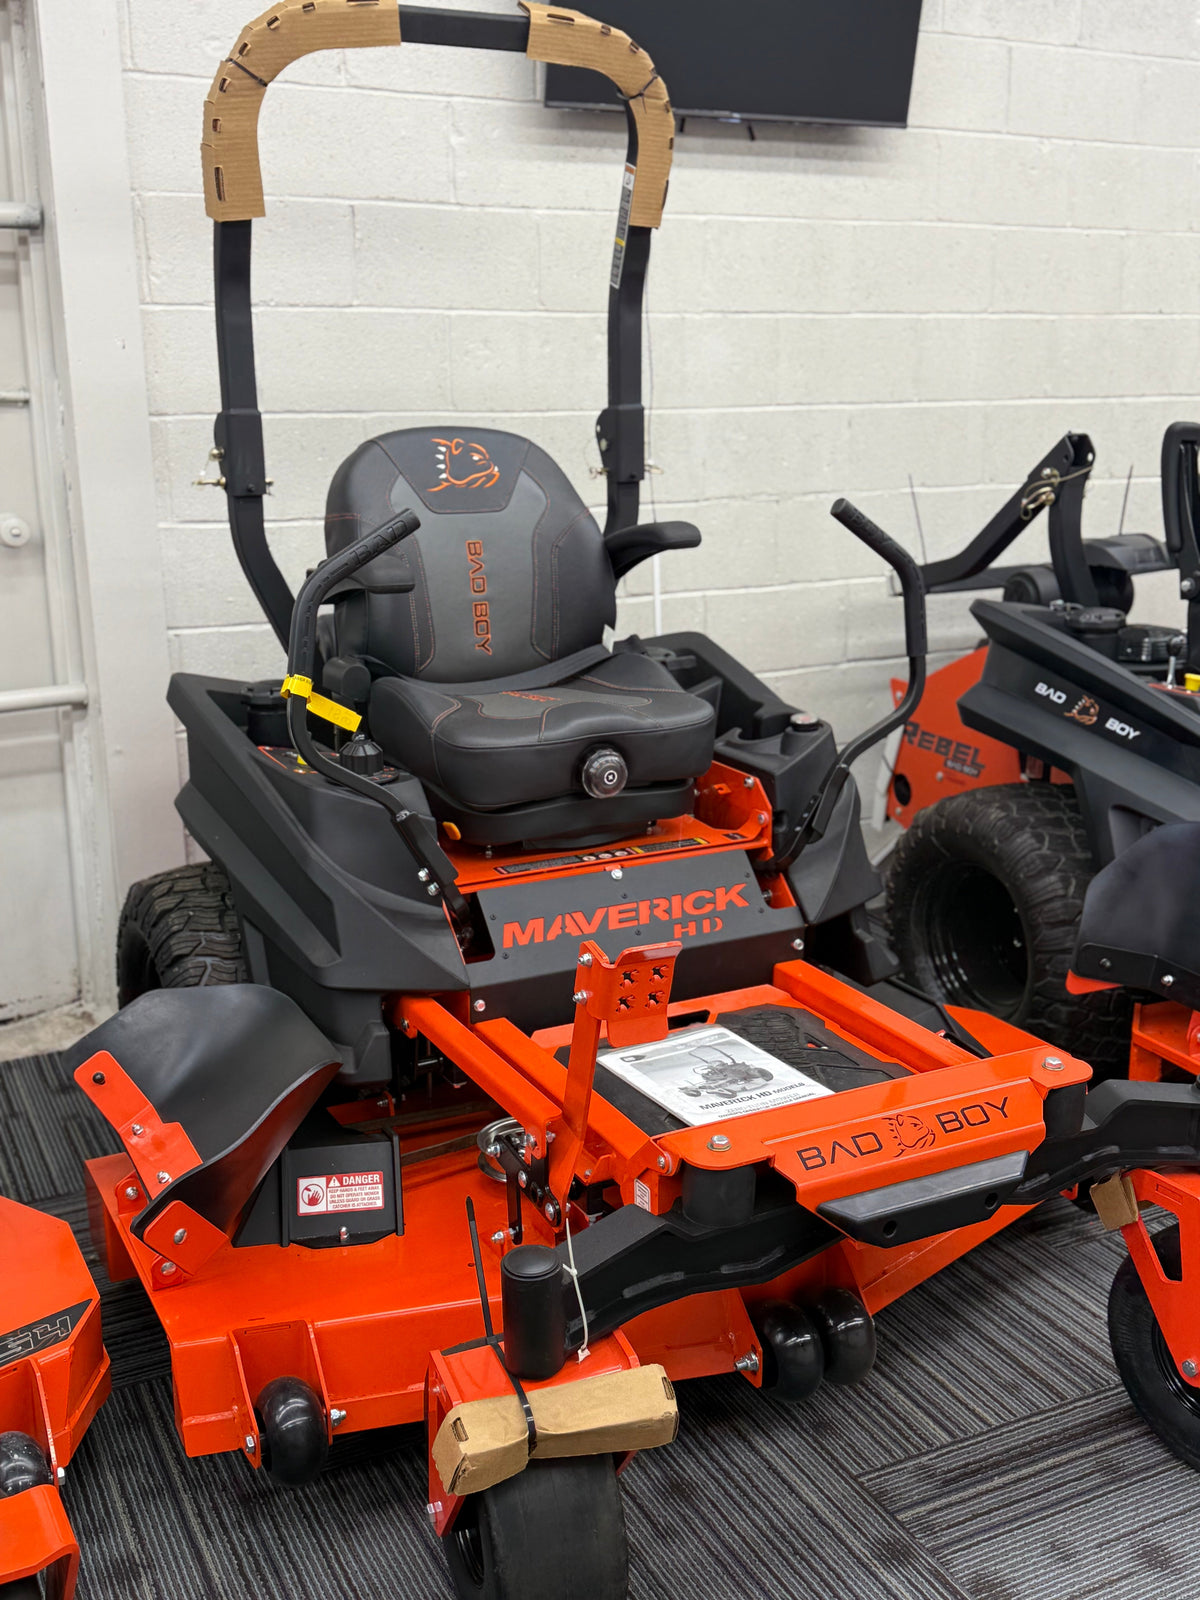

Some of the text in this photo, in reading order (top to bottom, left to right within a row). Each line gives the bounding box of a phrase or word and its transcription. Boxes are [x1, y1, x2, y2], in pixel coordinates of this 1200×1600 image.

[465, 540, 493, 656] BAD BOY
[1034, 681, 1141, 740] BAD BOY
[903, 720, 986, 770] REBEL
[502, 883, 750, 949] MAVERICK
[673, 917, 723, 939] HD
[699, 1095, 757, 1110] MAVERICK
[796, 1096, 1009, 1171] BAD BOY
[342, 1174, 380, 1185] DANGER
